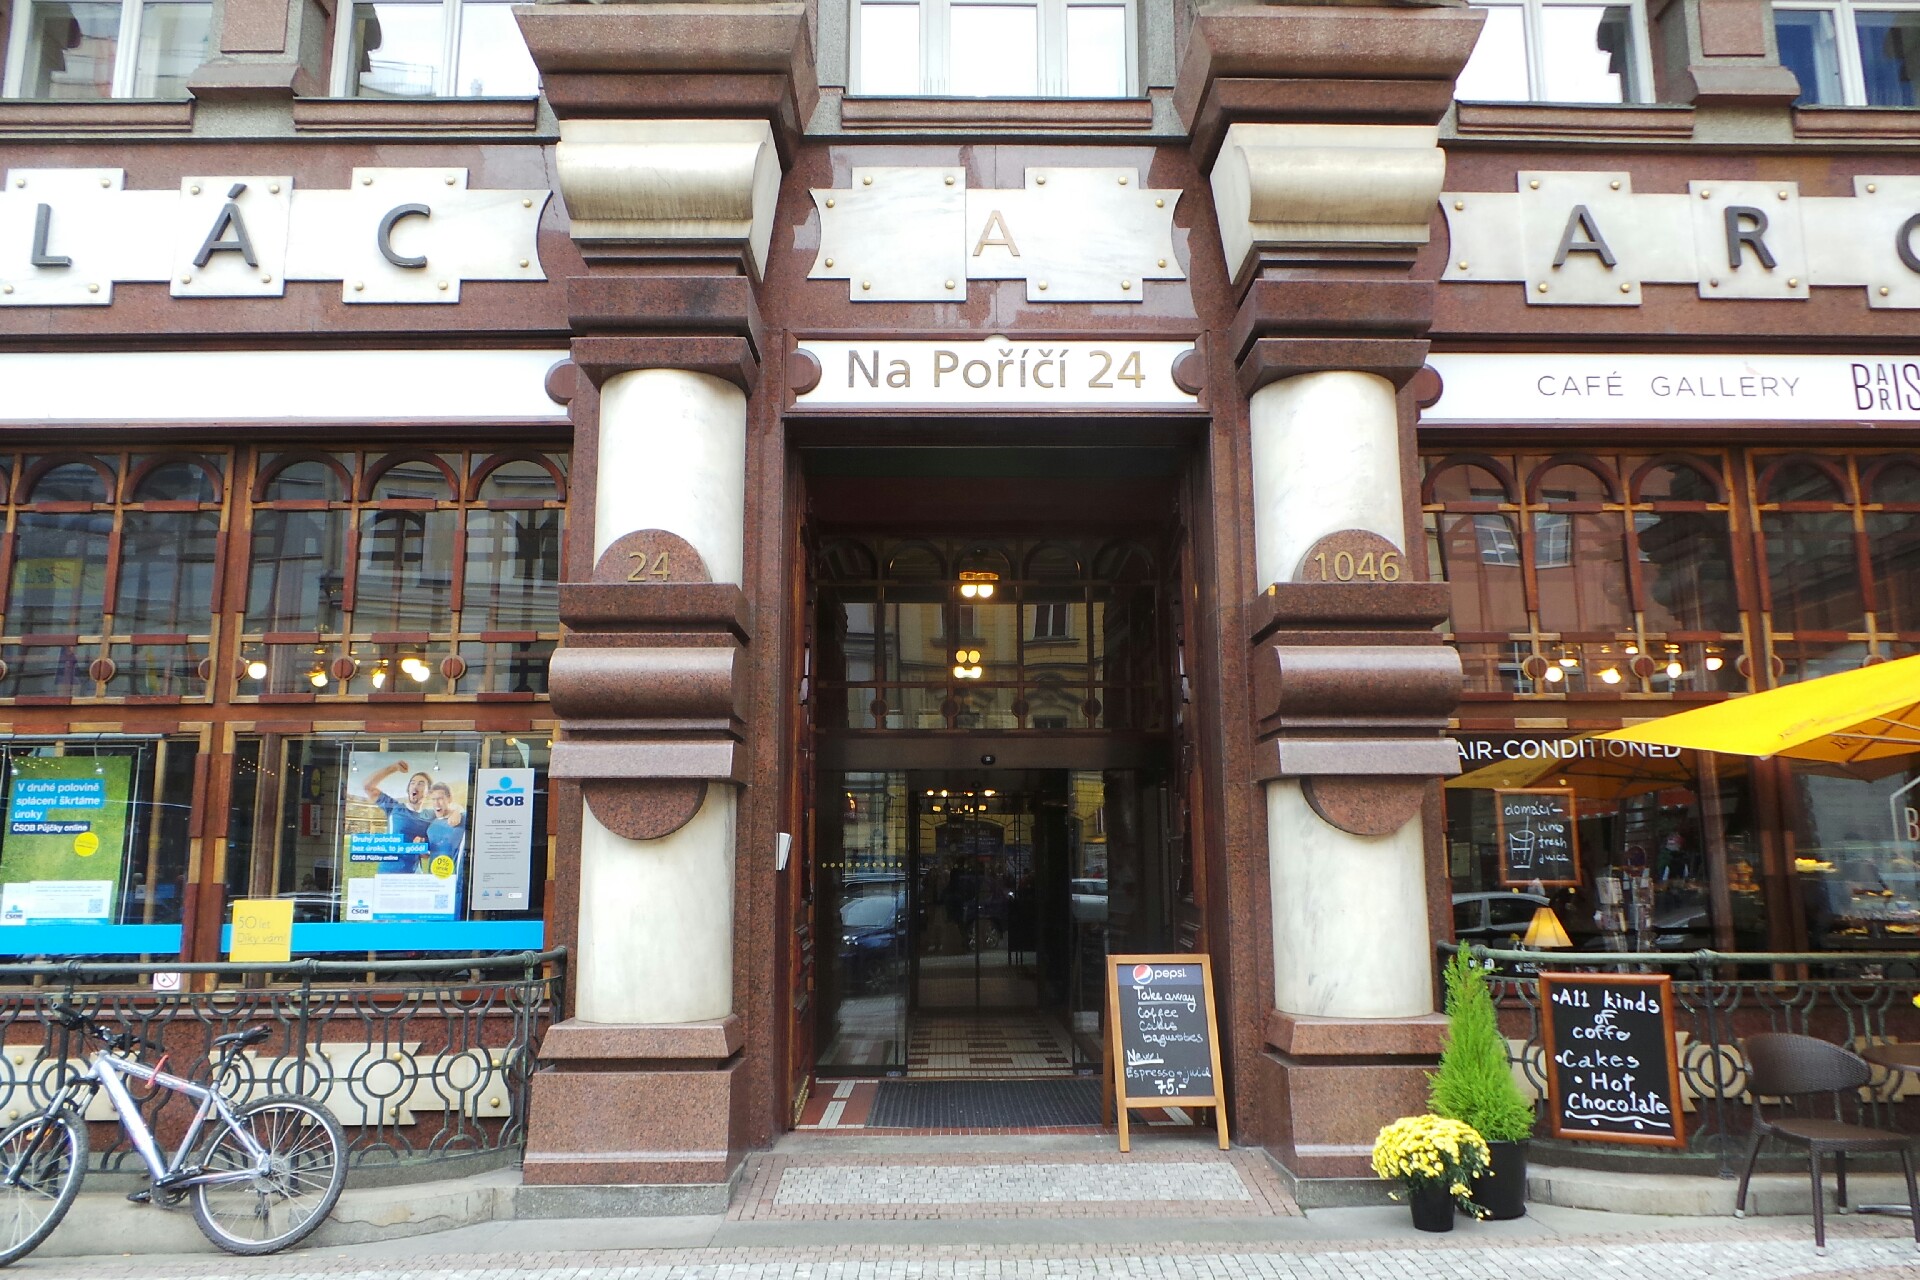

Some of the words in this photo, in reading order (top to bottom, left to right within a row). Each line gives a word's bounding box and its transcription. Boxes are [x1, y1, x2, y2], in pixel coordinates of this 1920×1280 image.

[972, 210, 1020, 257] A
[847, 350, 911, 389] Na
[933, 348, 1067, 389] Poříčí
[1088, 351, 1145, 388] 24
[1537, 371, 1624, 397] CAFÉ
[1650, 376, 1800, 397] GALLERY
[627, 551, 671, 582] 24
[1314, 551, 1400, 582] 1046
[1457, 739, 1681, 760] AIR-CONDITIONED
[17, 783, 26, 792] V
[27, 782, 56, 793] druhé
[57, 782, 100, 795] polovině
[16, 796, 57, 807] splácení
[59, 796, 101, 805] škrtáme
[485, 795, 525, 807] ČSOB
[14, 809, 43, 821] úroky
[12, 823, 36, 832] ČSOB
[37, 823, 63, 834] Půjčky
[352, 835, 373, 844] Druhý
[1538, 836, 1567, 848] fresh
[1154, 968, 1187, 980] pepsi
[1132, 985, 1163, 1001] Take
[1164, 991, 1197, 1013] away
[1559, 988, 1590, 1008] All
[1604, 989, 1660, 1014] kinds
[1562, 1050, 1640, 1068] Cakes
[1126, 1066, 1175, 1081] Espresso
[1591, 1072, 1636, 1092] Hot
[1568, 1091, 1671, 1115] Chocolate
